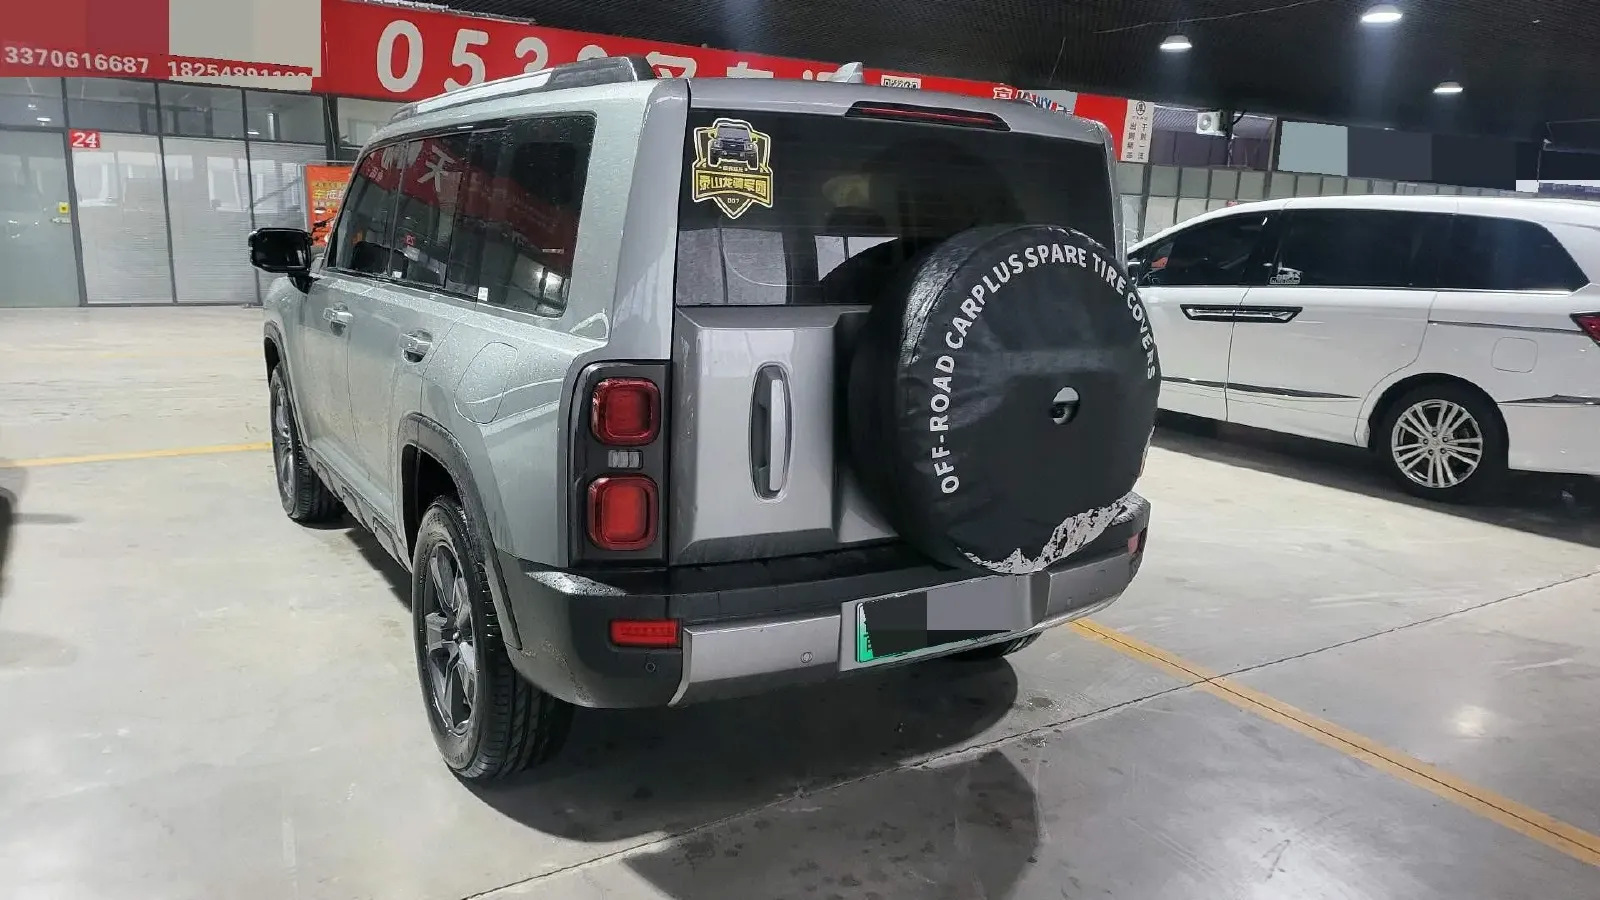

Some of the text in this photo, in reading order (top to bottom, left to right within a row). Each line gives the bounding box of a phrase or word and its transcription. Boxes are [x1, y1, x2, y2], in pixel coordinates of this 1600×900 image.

[4, 46, 149, 74] 3370616687
[167, 61, 308, 76] 1825489
[72, 132, 97, 148] 24
[929, 354, 960, 495] OFF-ROAD
[1023, 243, 1087, 269] SPARE
[1092, 252, 1127, 295] TIRE
[1126, 291, 1156, 380] COVERS
